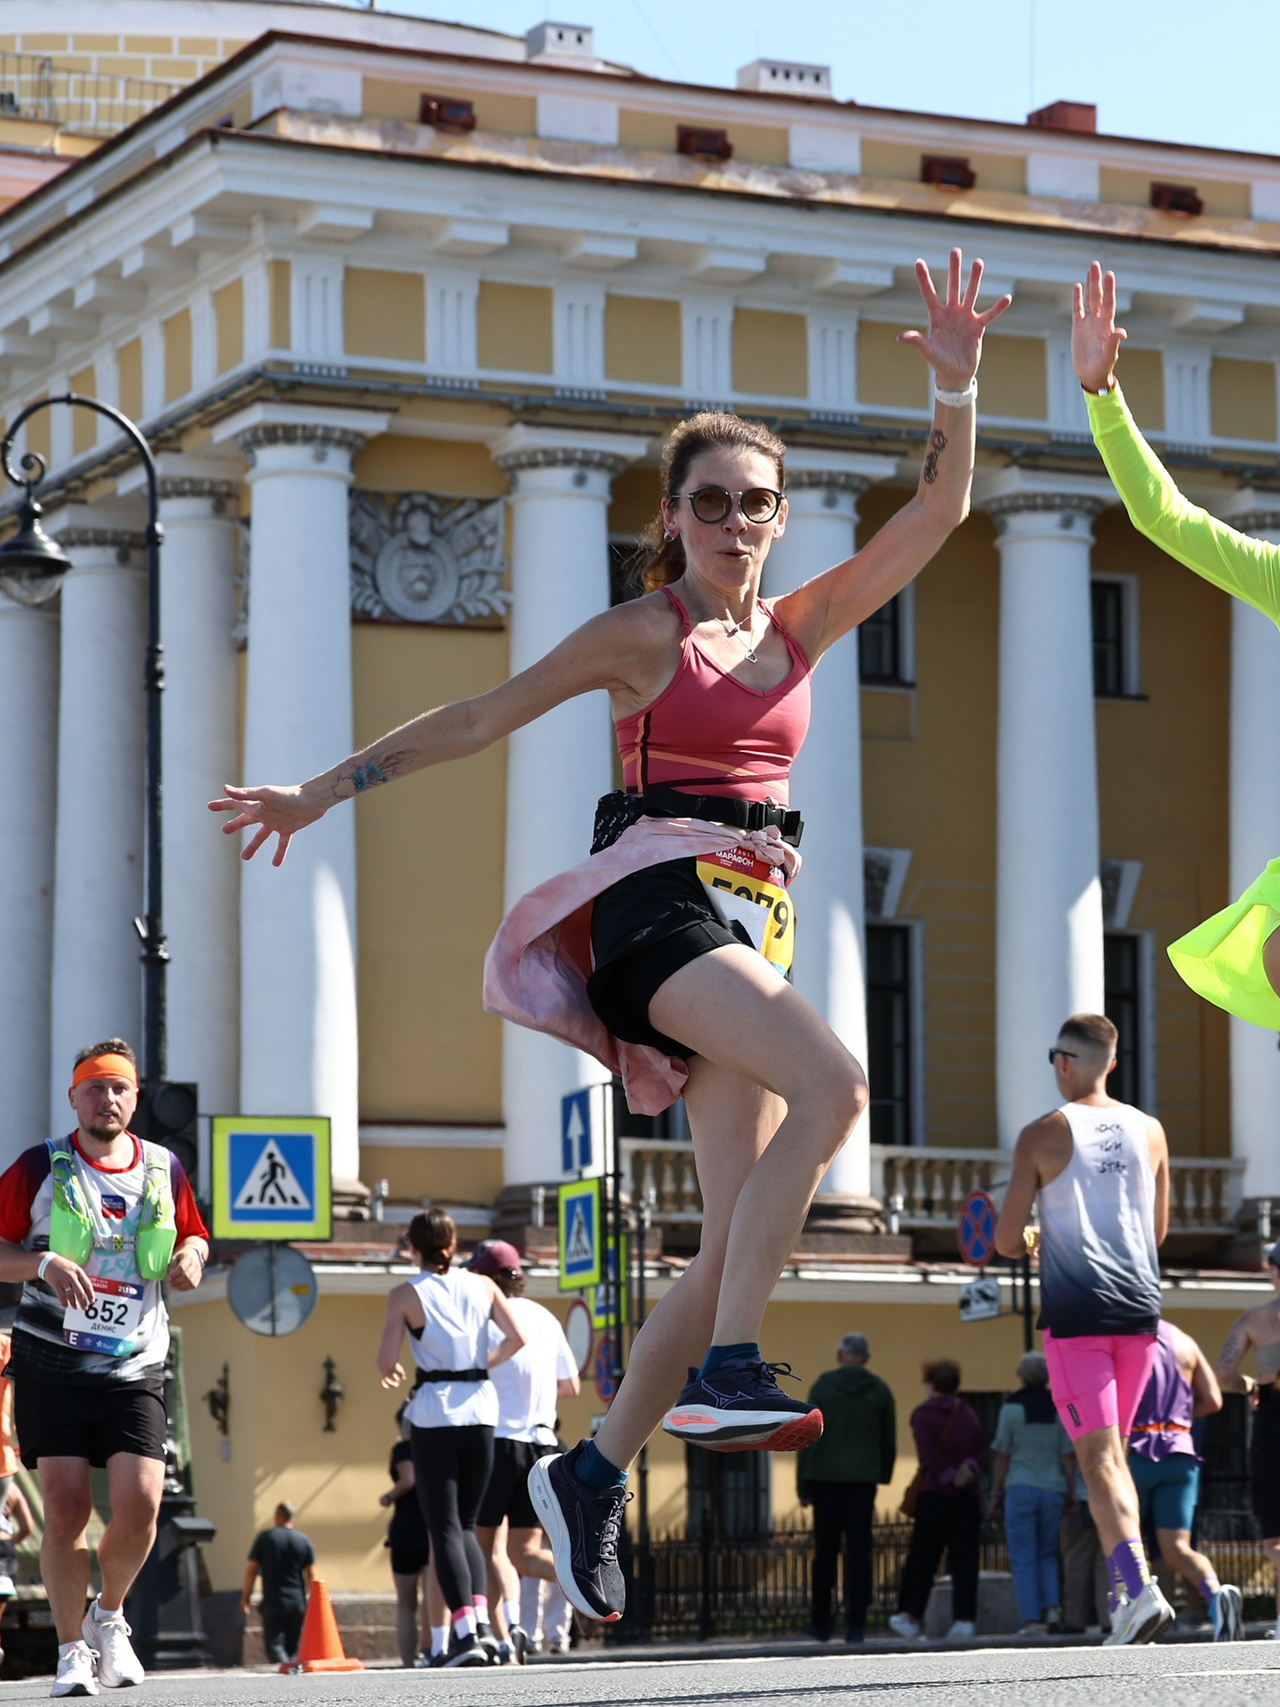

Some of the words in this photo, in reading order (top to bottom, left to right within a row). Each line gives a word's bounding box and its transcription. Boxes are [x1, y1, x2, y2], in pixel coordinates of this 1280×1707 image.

[715, 851, 754, 868] МАРАФОН
[90, 1322, 117, 1333] ДЕНИС
[69, 1331, 79, 1345] E
